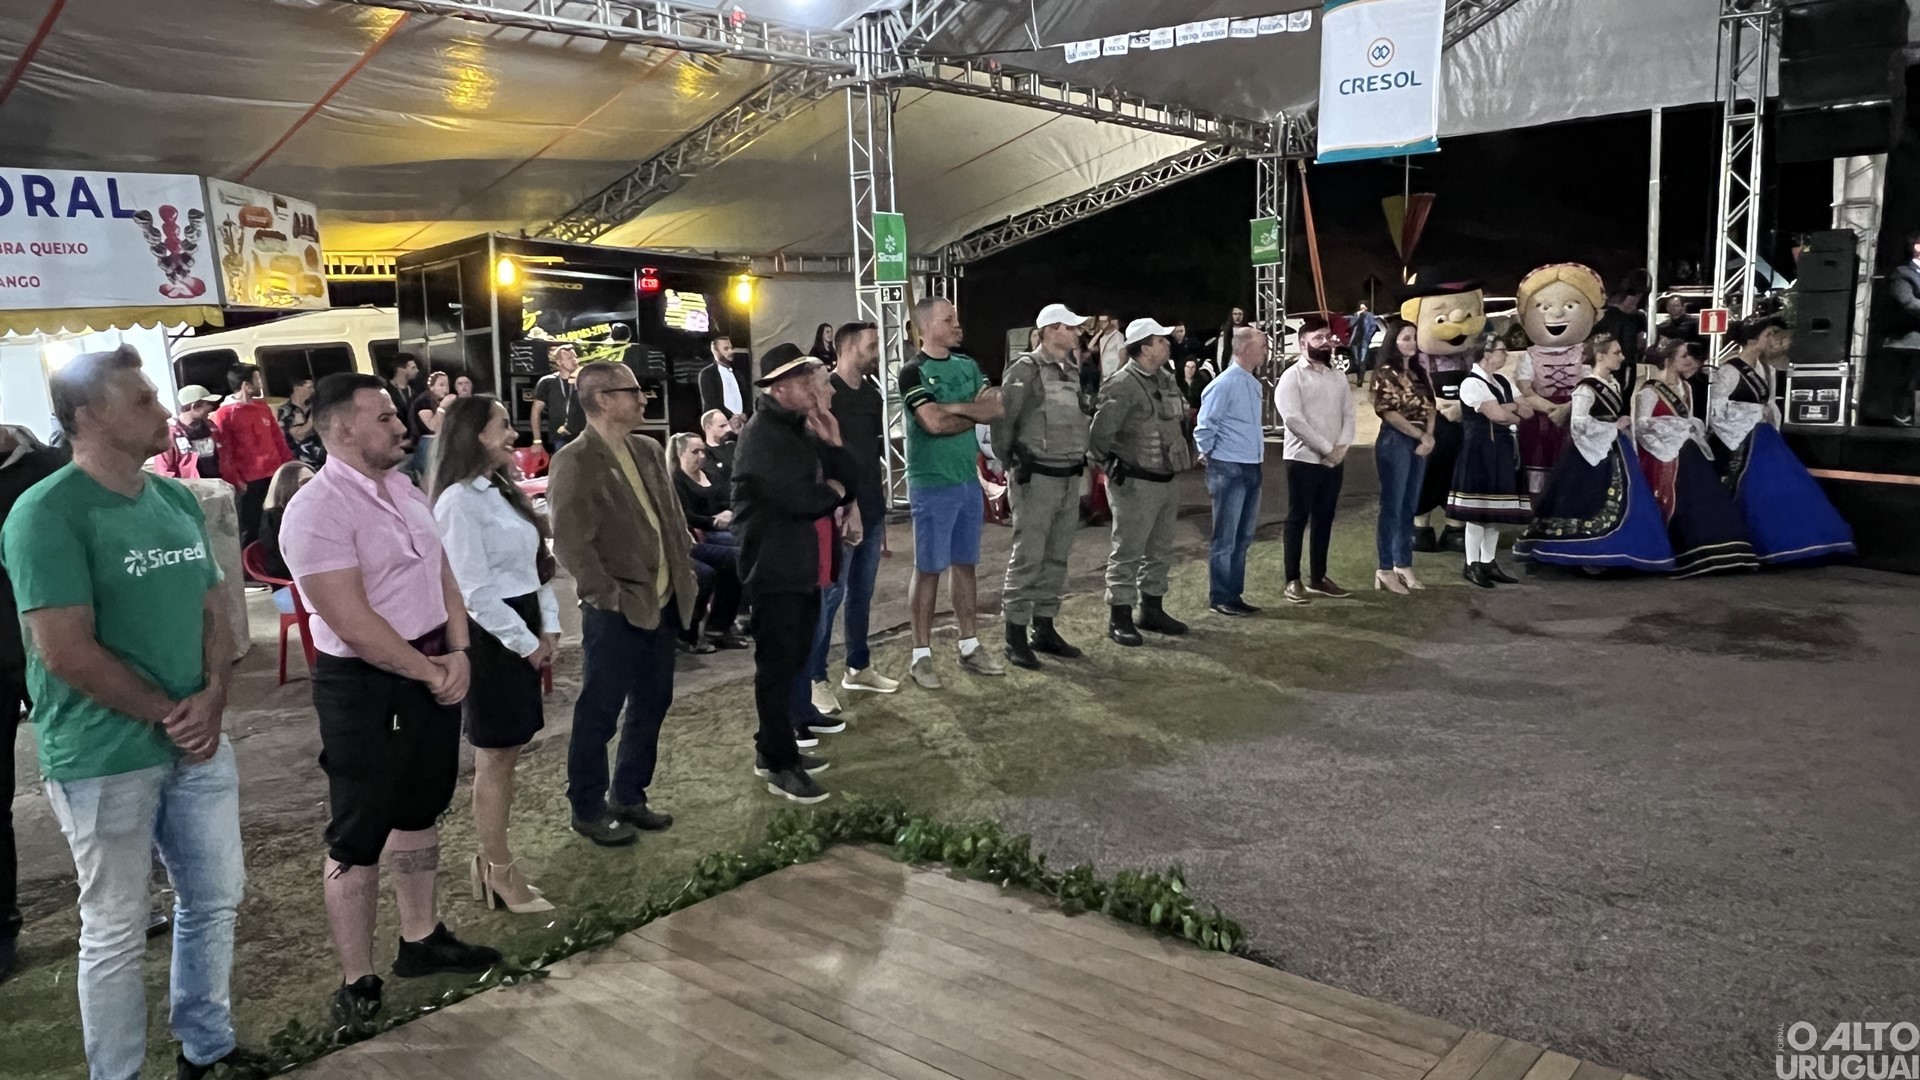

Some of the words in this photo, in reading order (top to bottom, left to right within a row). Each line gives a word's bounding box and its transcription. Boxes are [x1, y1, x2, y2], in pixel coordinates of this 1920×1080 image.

[1339, 70, 1422, 95] CRESOL
[0, 242, 26, 254] RA
[30, 242, 88, 256] QUEIXO
